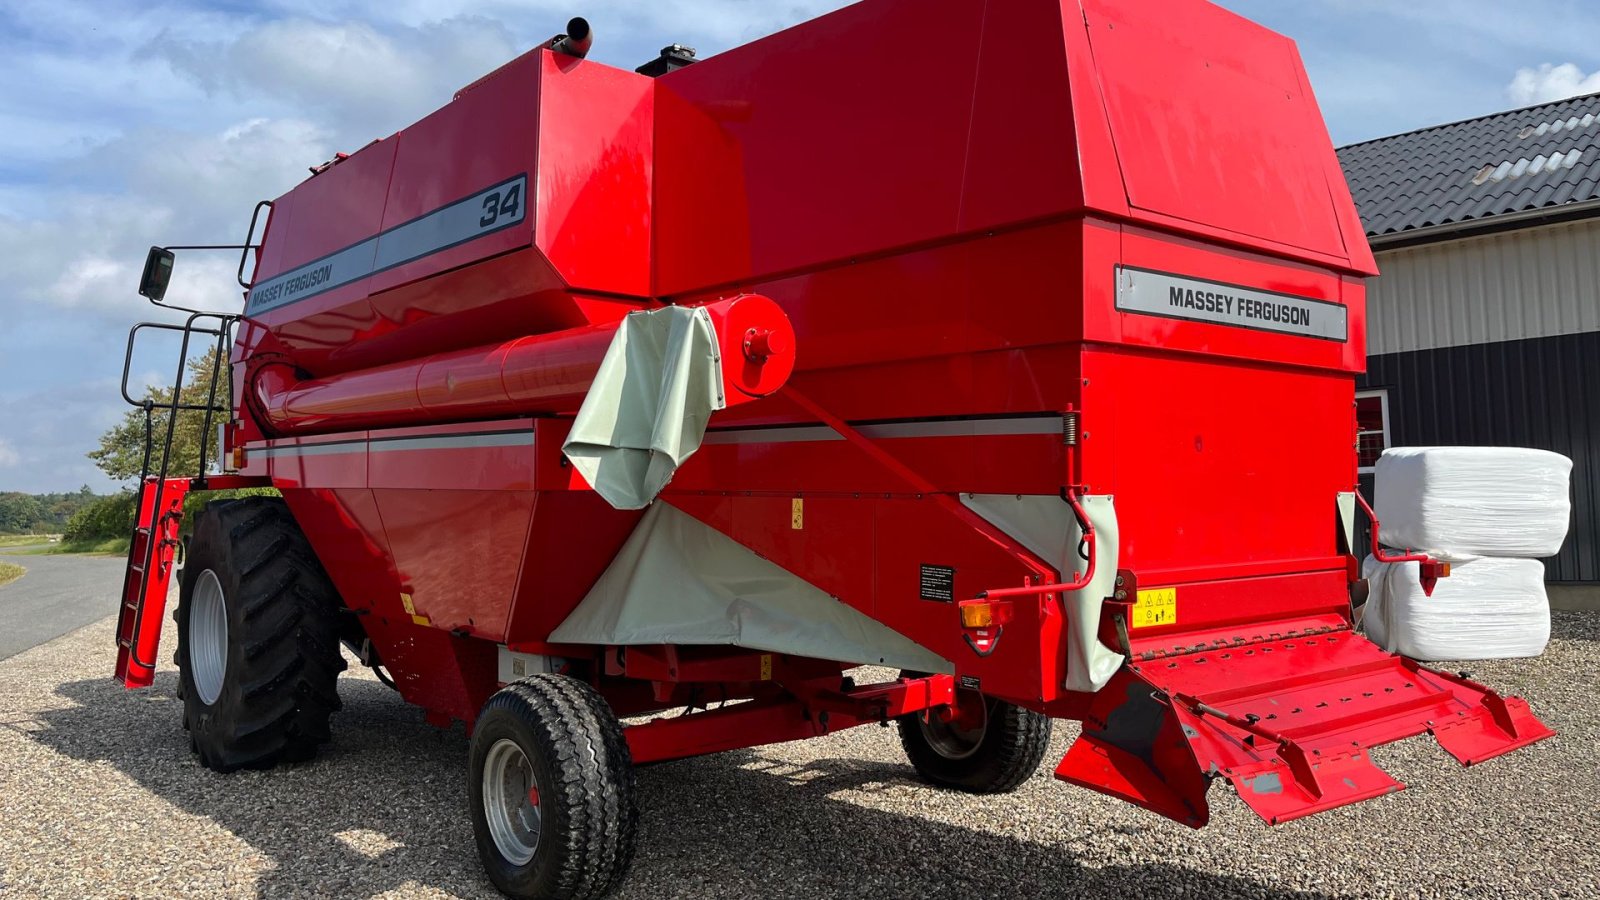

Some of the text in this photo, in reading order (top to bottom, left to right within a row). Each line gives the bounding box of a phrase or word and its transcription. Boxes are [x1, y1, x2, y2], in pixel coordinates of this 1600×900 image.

[480, 184, 520, 228] 34
[252, 264, 332, 308] MASSEY FERGUSON
[1169, 286, 1310, 326] MASSEY FERGUSON
